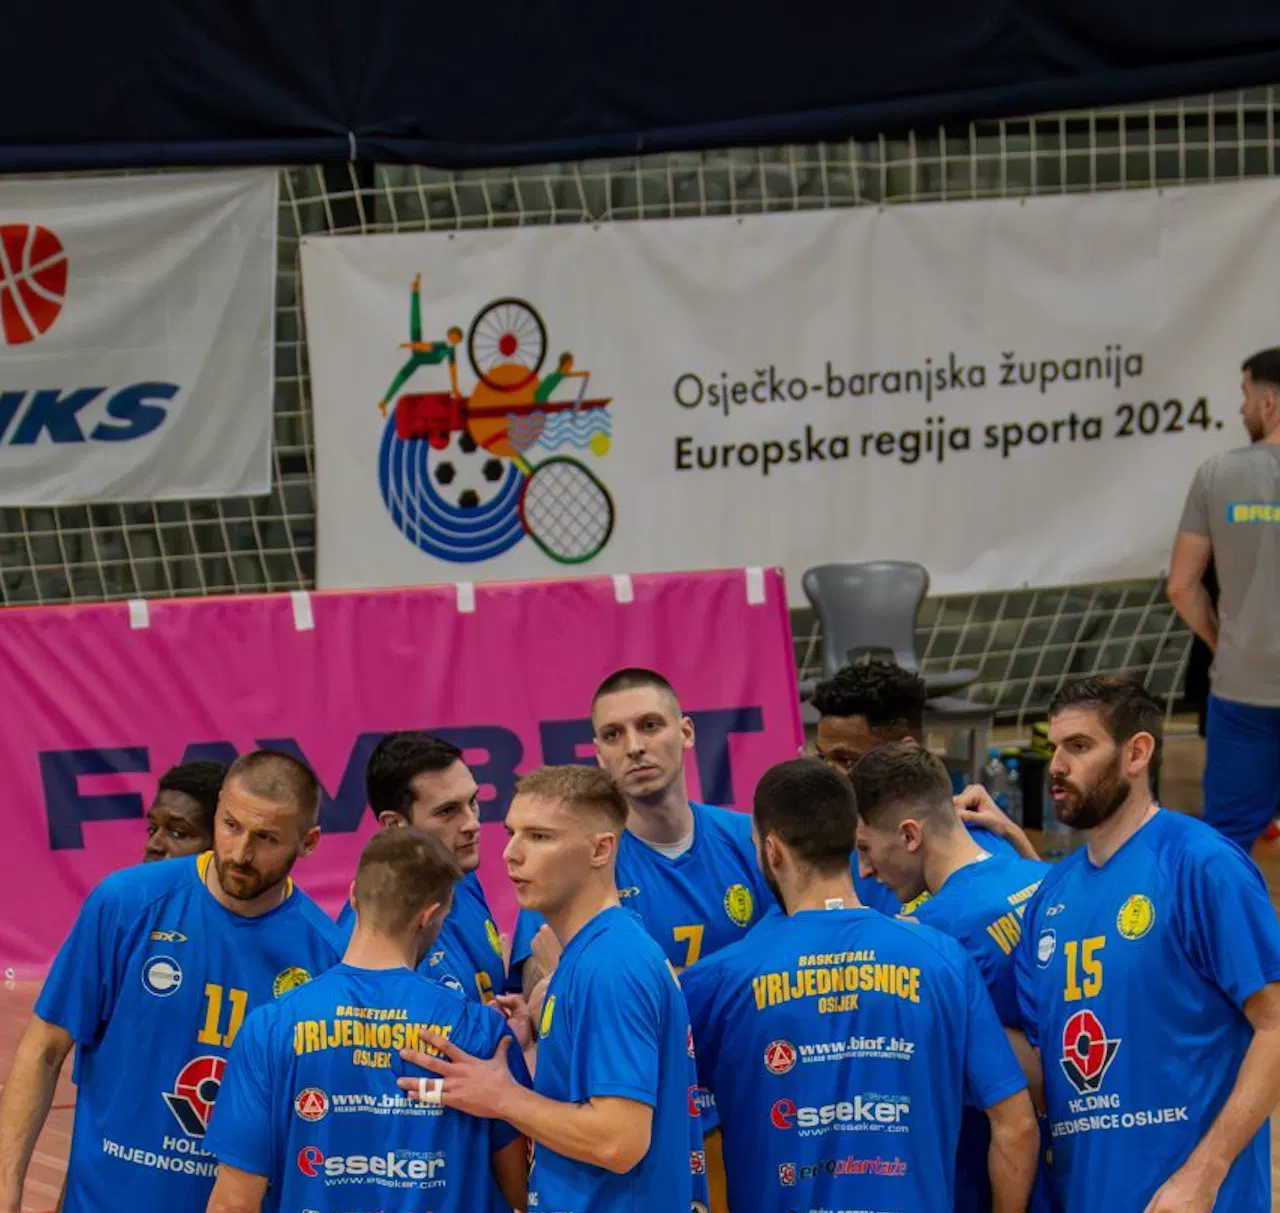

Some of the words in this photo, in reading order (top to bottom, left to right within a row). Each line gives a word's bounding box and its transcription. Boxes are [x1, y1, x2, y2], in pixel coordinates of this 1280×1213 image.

[673, 352, 986, 417] Osječko-baranjska
[999, 344, 1144, 394] županija
[675, 423, 850, 477] Europska
[859, 415, 971, 464] regija
[984, 411, 1103, 459] sporta
[1114, 396, 1225, 438] 2024.
[673, 924, 704, 967] 7
[798, 950, 876, 967] BASKETBALL
[752, 964, 920, 1010] VRIJEDNOSNICE
[1064, 935, 1107, 1002] 15
[197, 983, 248, 1048] 11
[336, 1005, 408, 1020] BASKETBALL
[818, 993, 859, 1014] OSIJEK
[771, 1095, 910, 1130] esseker
[1121, 1107, 1189, 1128] OSIJEK
[297, 1146, 446, 1178] esseker
